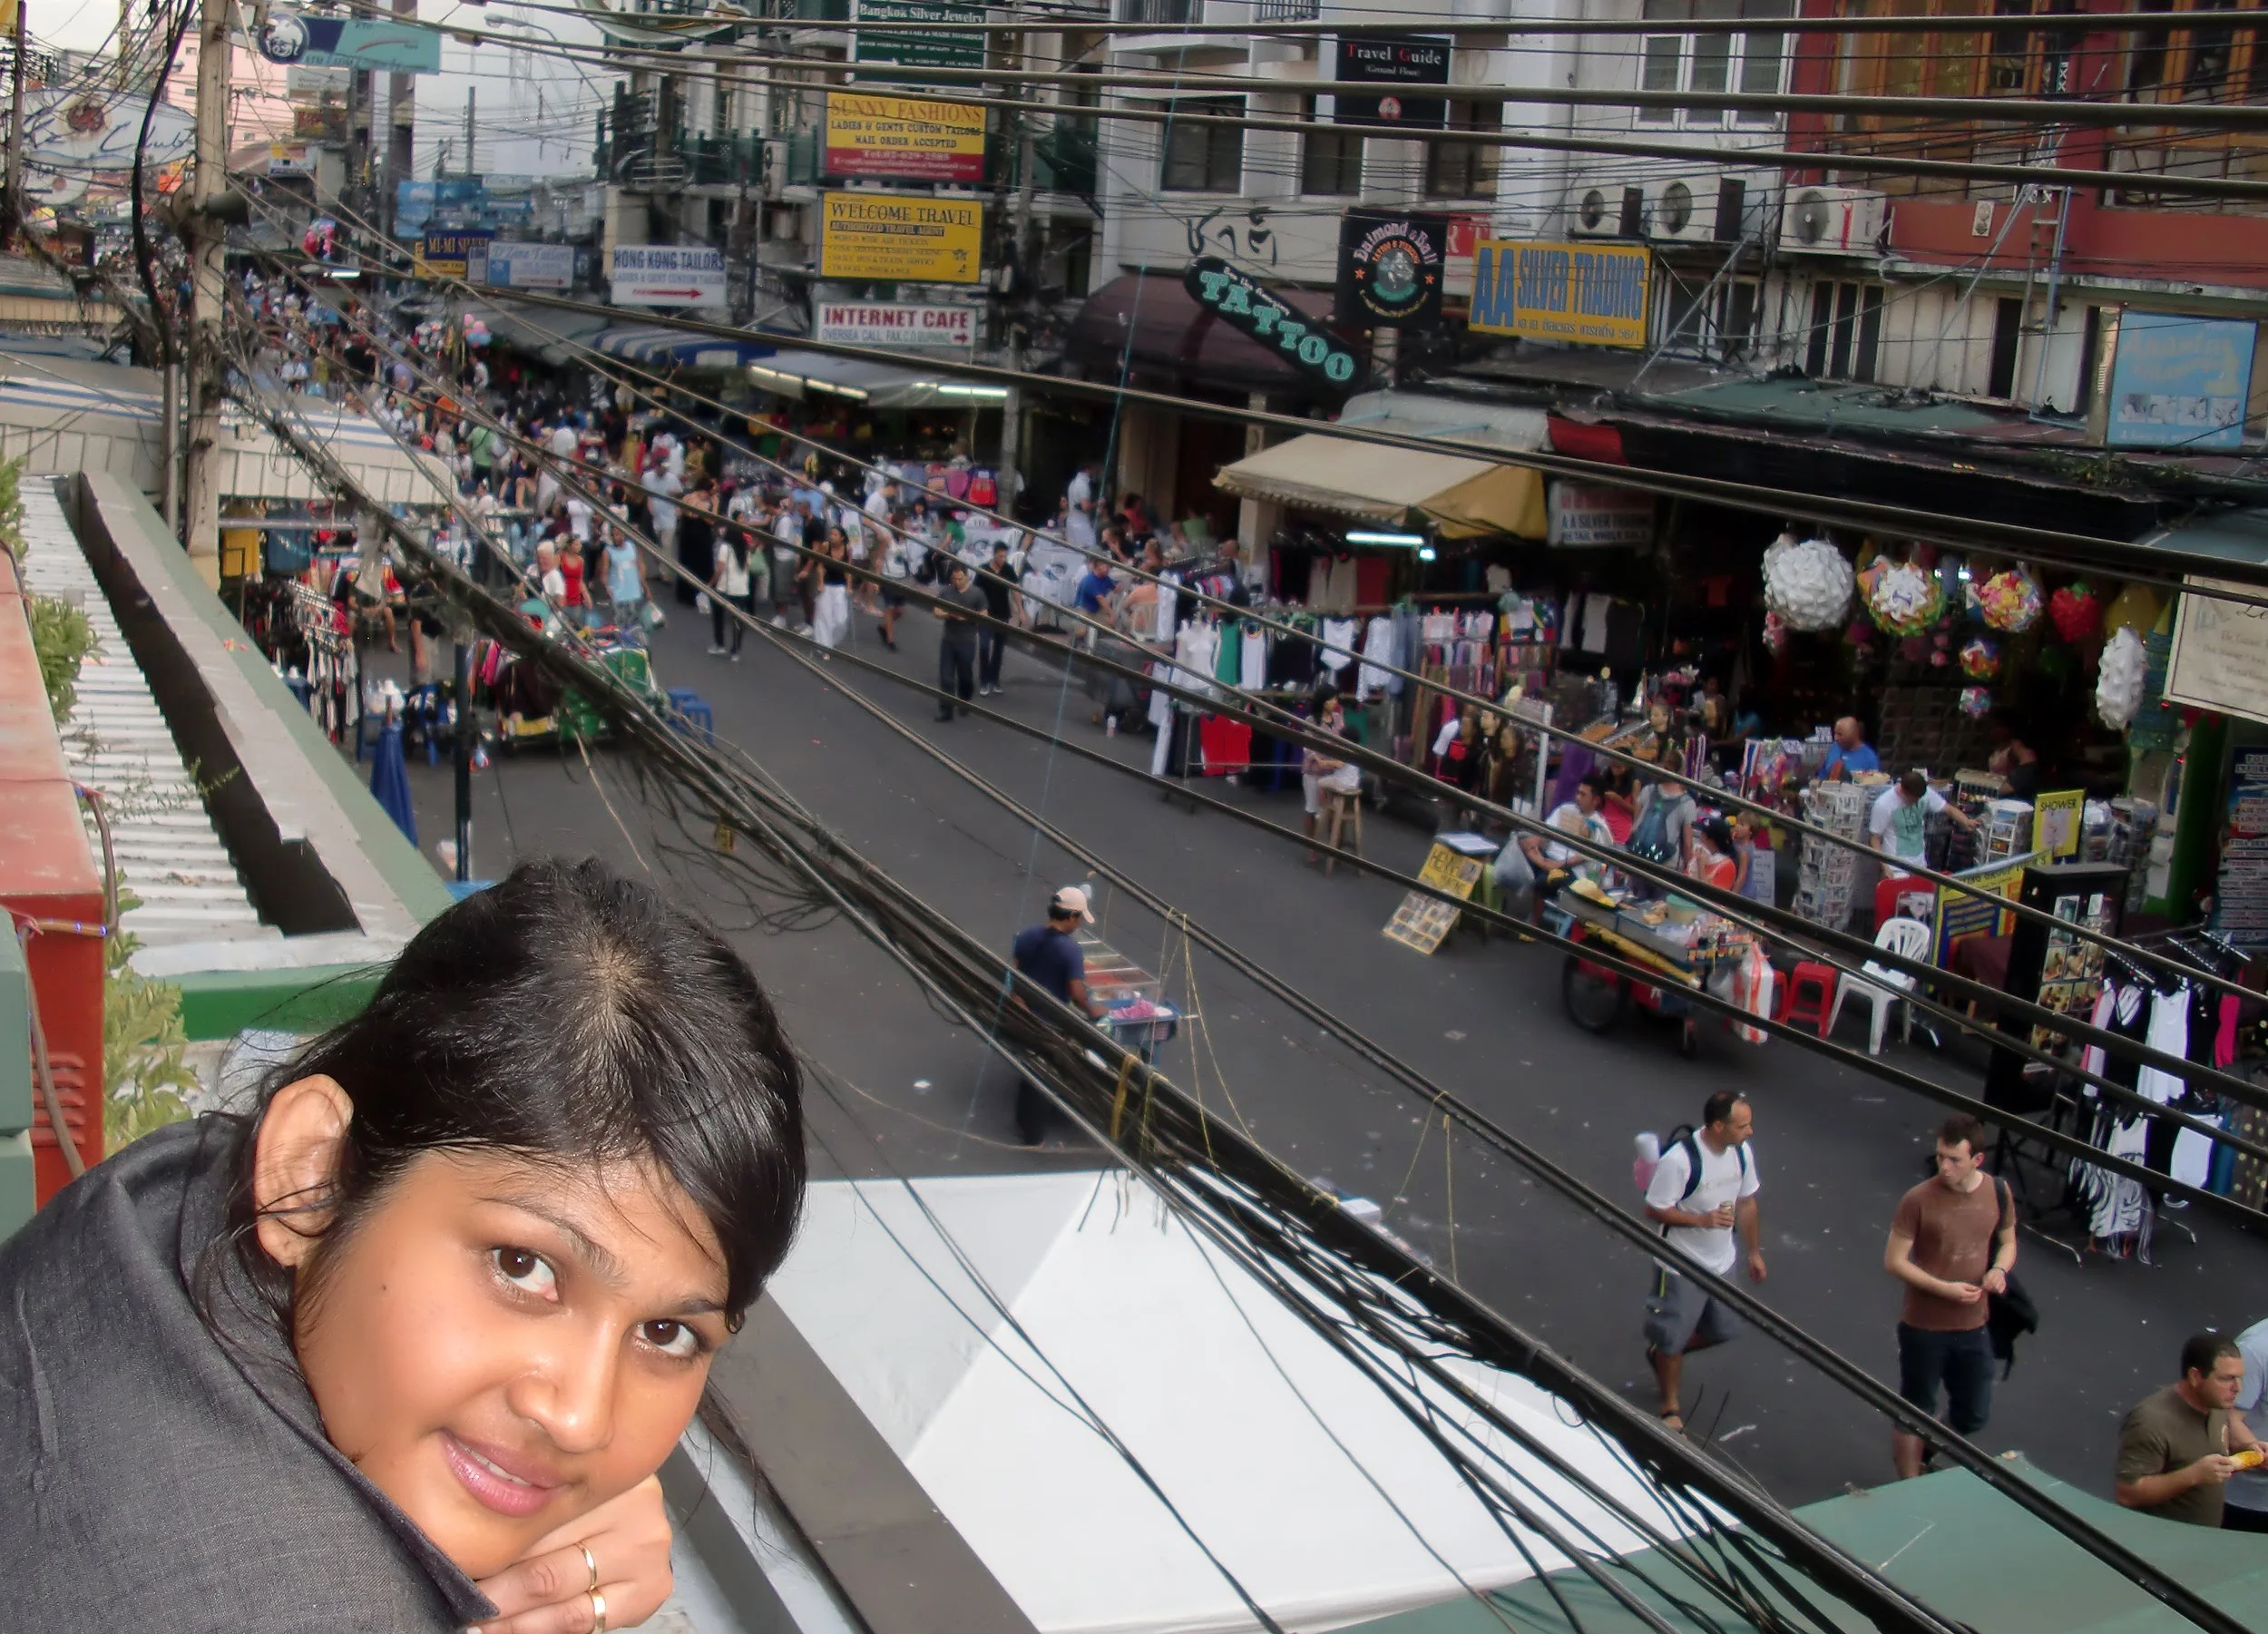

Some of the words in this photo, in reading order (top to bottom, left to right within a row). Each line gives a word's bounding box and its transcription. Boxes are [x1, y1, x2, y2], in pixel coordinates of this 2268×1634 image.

[860, 4, 907, 19] Bangkok
[910, 7, 942, 21] Silver
[943, 9, 984, 24] Jewelry
[1346, 44, 1392, 61] Travel
[1399, 46, 1442, 65] Guide
[831, 99, 887, 117] SUNNY
[897, 101, 982, 122] FASHIONS
[831, 121, 861, 131] LADIES
[876, 122, 904, 132] GENTS
[908, 123, 942, 134] CUSTOM
[855, 135, 875, 145] MAIL
[881, 136, 908, 146] ORDER
[914, 138, 957, 148] ACCEPTED
[832, 202, 912, 220] WELCOME
[917, 208, 973, 225] TRAVEL
[613, 250, 645, 269] HONG
[648, 250, 677, 269] KONG
[680, 251, 725, 271] TAILORS
[1471, 247, 1514, 327] AA
[1517, 248, 1570, 312] SILVER
[1573, 252, 1646, 320] TRADING
[825, 307, 916, 327] INTERNET
[923, 310, 969, 328] CAFE
[1199, 271, 1354, 381] TATTOO
[2040, 798, 2077, 813] SHOWER
